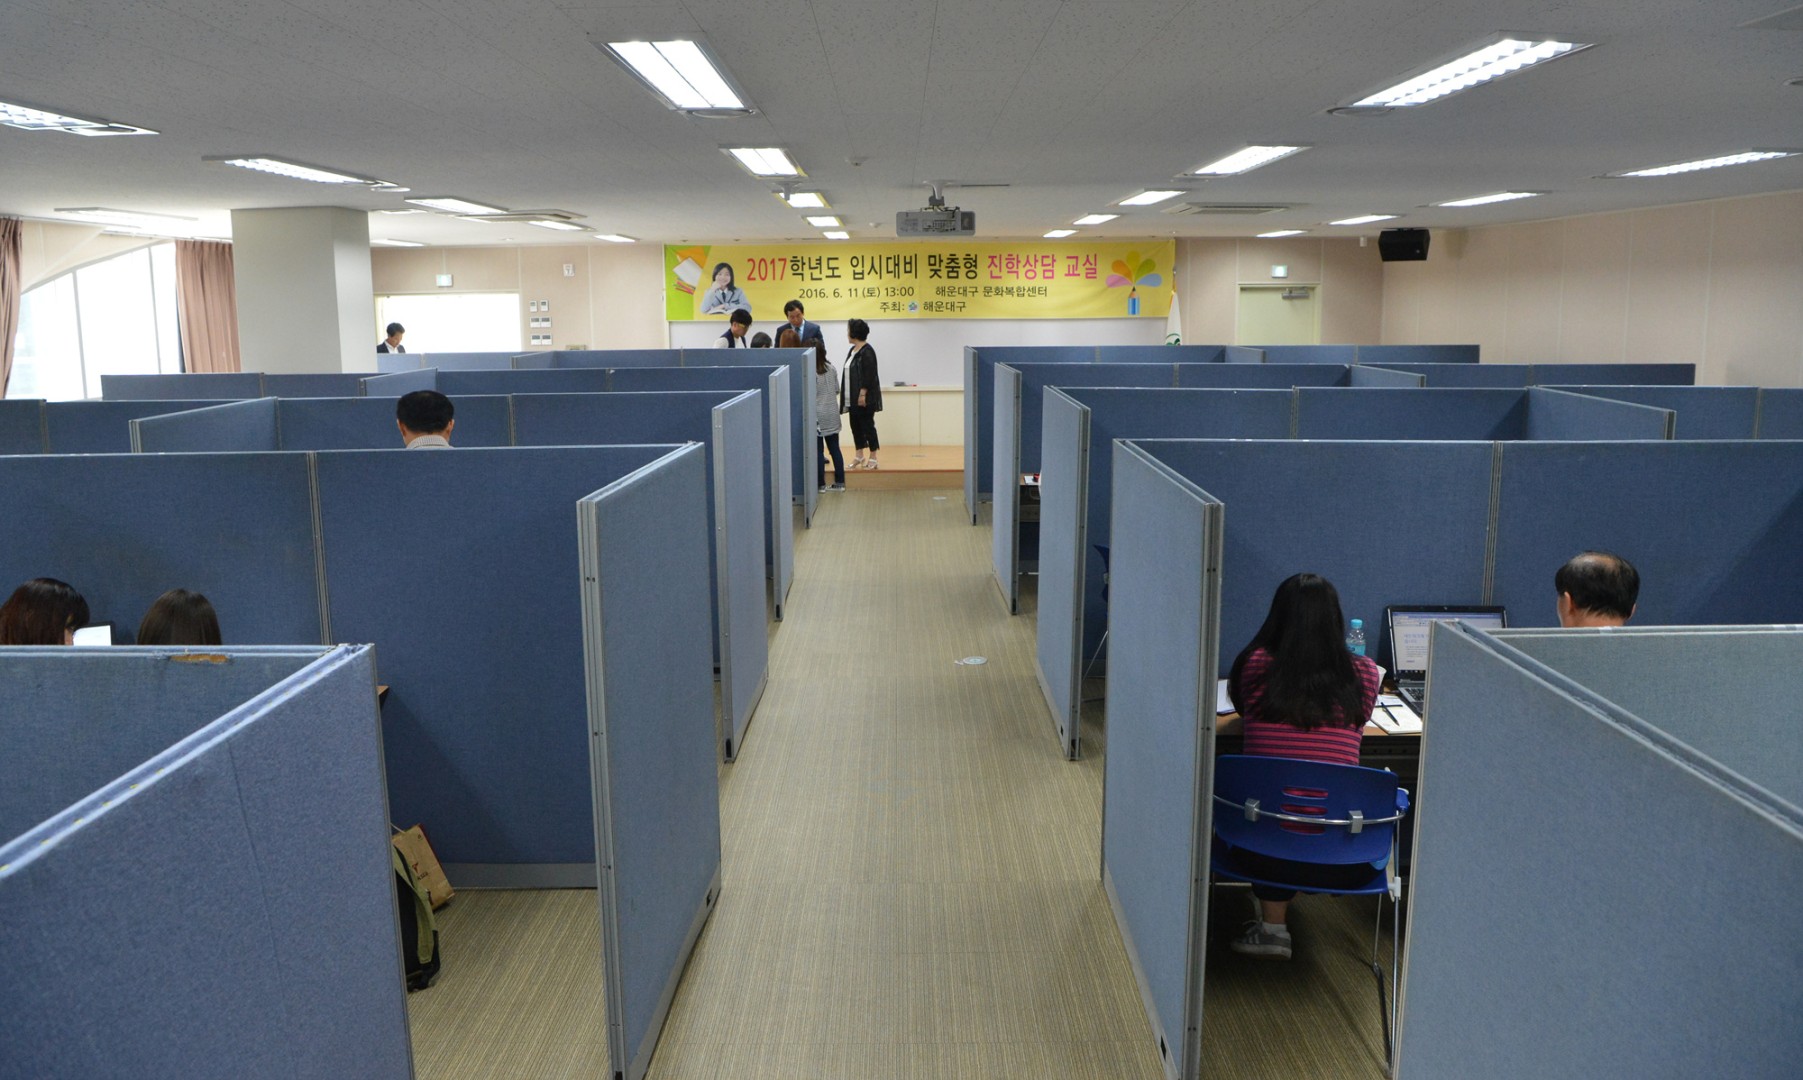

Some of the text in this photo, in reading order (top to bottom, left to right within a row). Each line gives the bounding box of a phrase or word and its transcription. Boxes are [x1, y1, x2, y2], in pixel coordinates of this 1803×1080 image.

[747, 253, 1098, 281] 2017학년도 입시대비 맞춤형 진학상담 교실
[799, 288, 829, 298] 2016.
[833, 288, 843, 298] 6.
[885, 286, 915, 297] 13:00
[935, 286, 978, 297] 해운대구
[982, 286, 1048, 297] 문화복합센터
[880, 301, 967, 312] 주최: 해운대구
